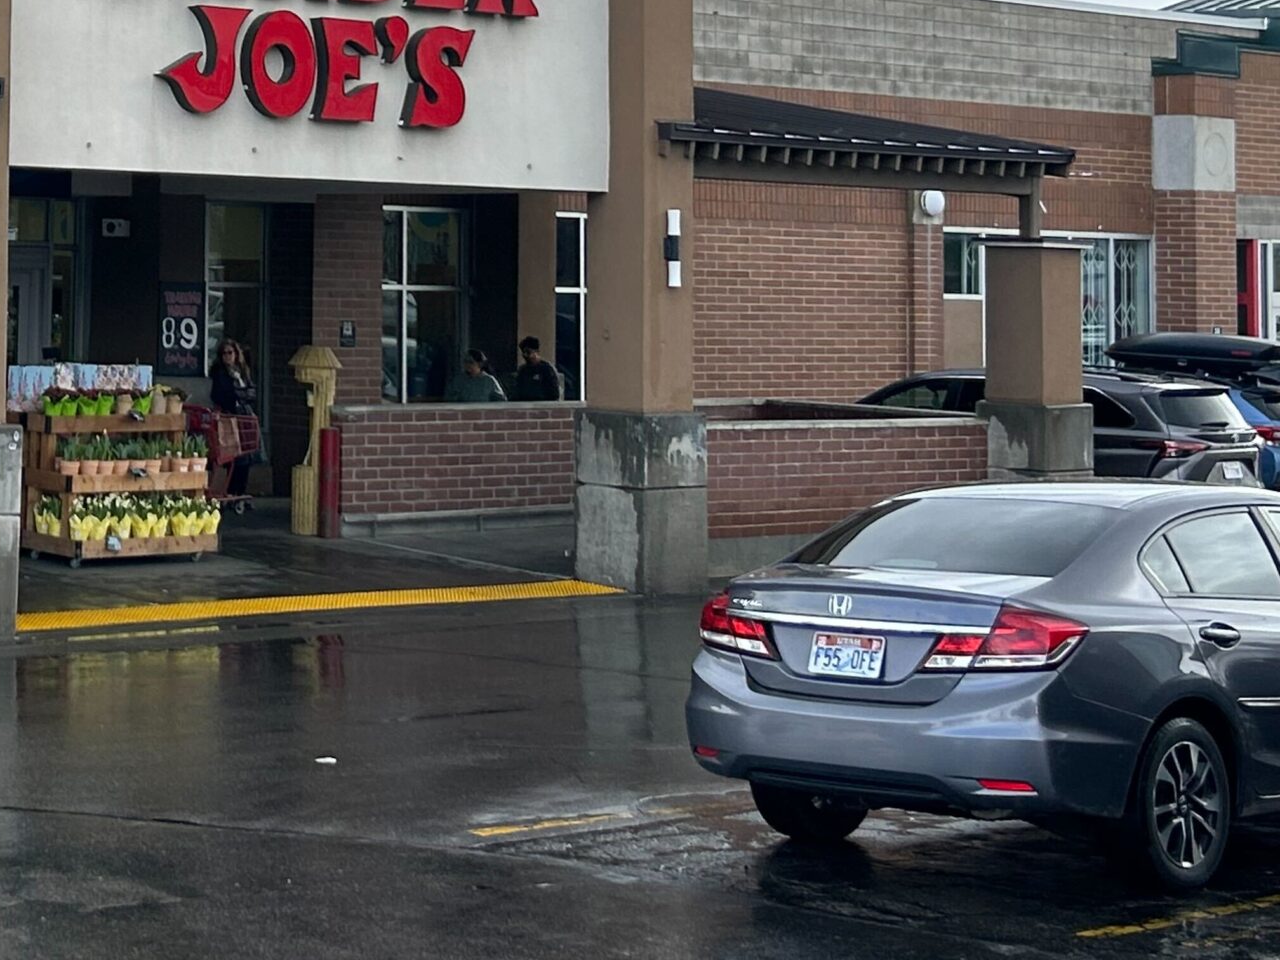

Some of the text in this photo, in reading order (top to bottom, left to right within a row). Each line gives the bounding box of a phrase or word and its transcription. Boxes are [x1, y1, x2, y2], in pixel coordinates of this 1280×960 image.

[154, 4, 476, 129] JOE'S
[162, 317, 198, 349] 8 9
[813, 646, 842, 669] F55
